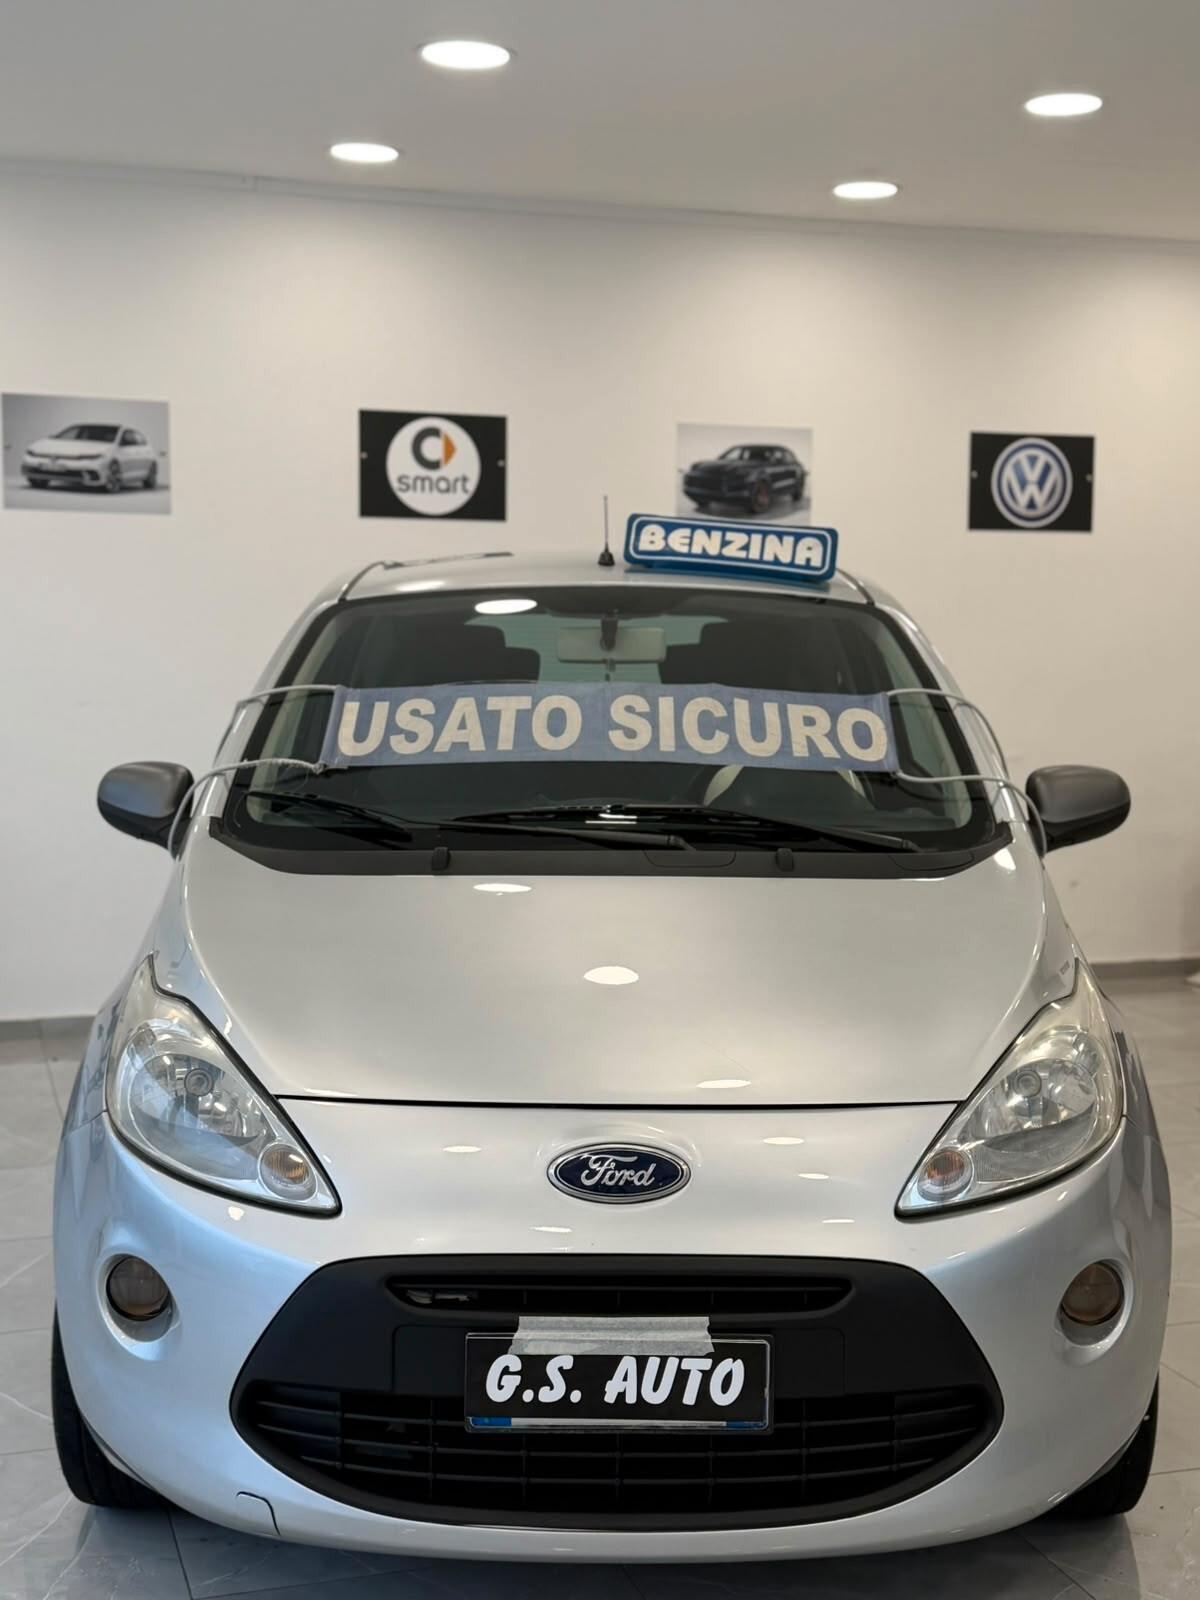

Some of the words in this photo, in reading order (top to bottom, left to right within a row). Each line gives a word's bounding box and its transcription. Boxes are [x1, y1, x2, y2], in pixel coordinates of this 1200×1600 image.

[397, 474, 470, 494] smart
[638, 524, 823, 567] BENZINA
[337, 695, 583, 756] USATO
[608, 694, 889, 762] SICURO
[580, 1153, 657, 1186] Ford
[485, 1354, 582, 1404] G.S.
[603, 1355, 745, 1407] AUTO
